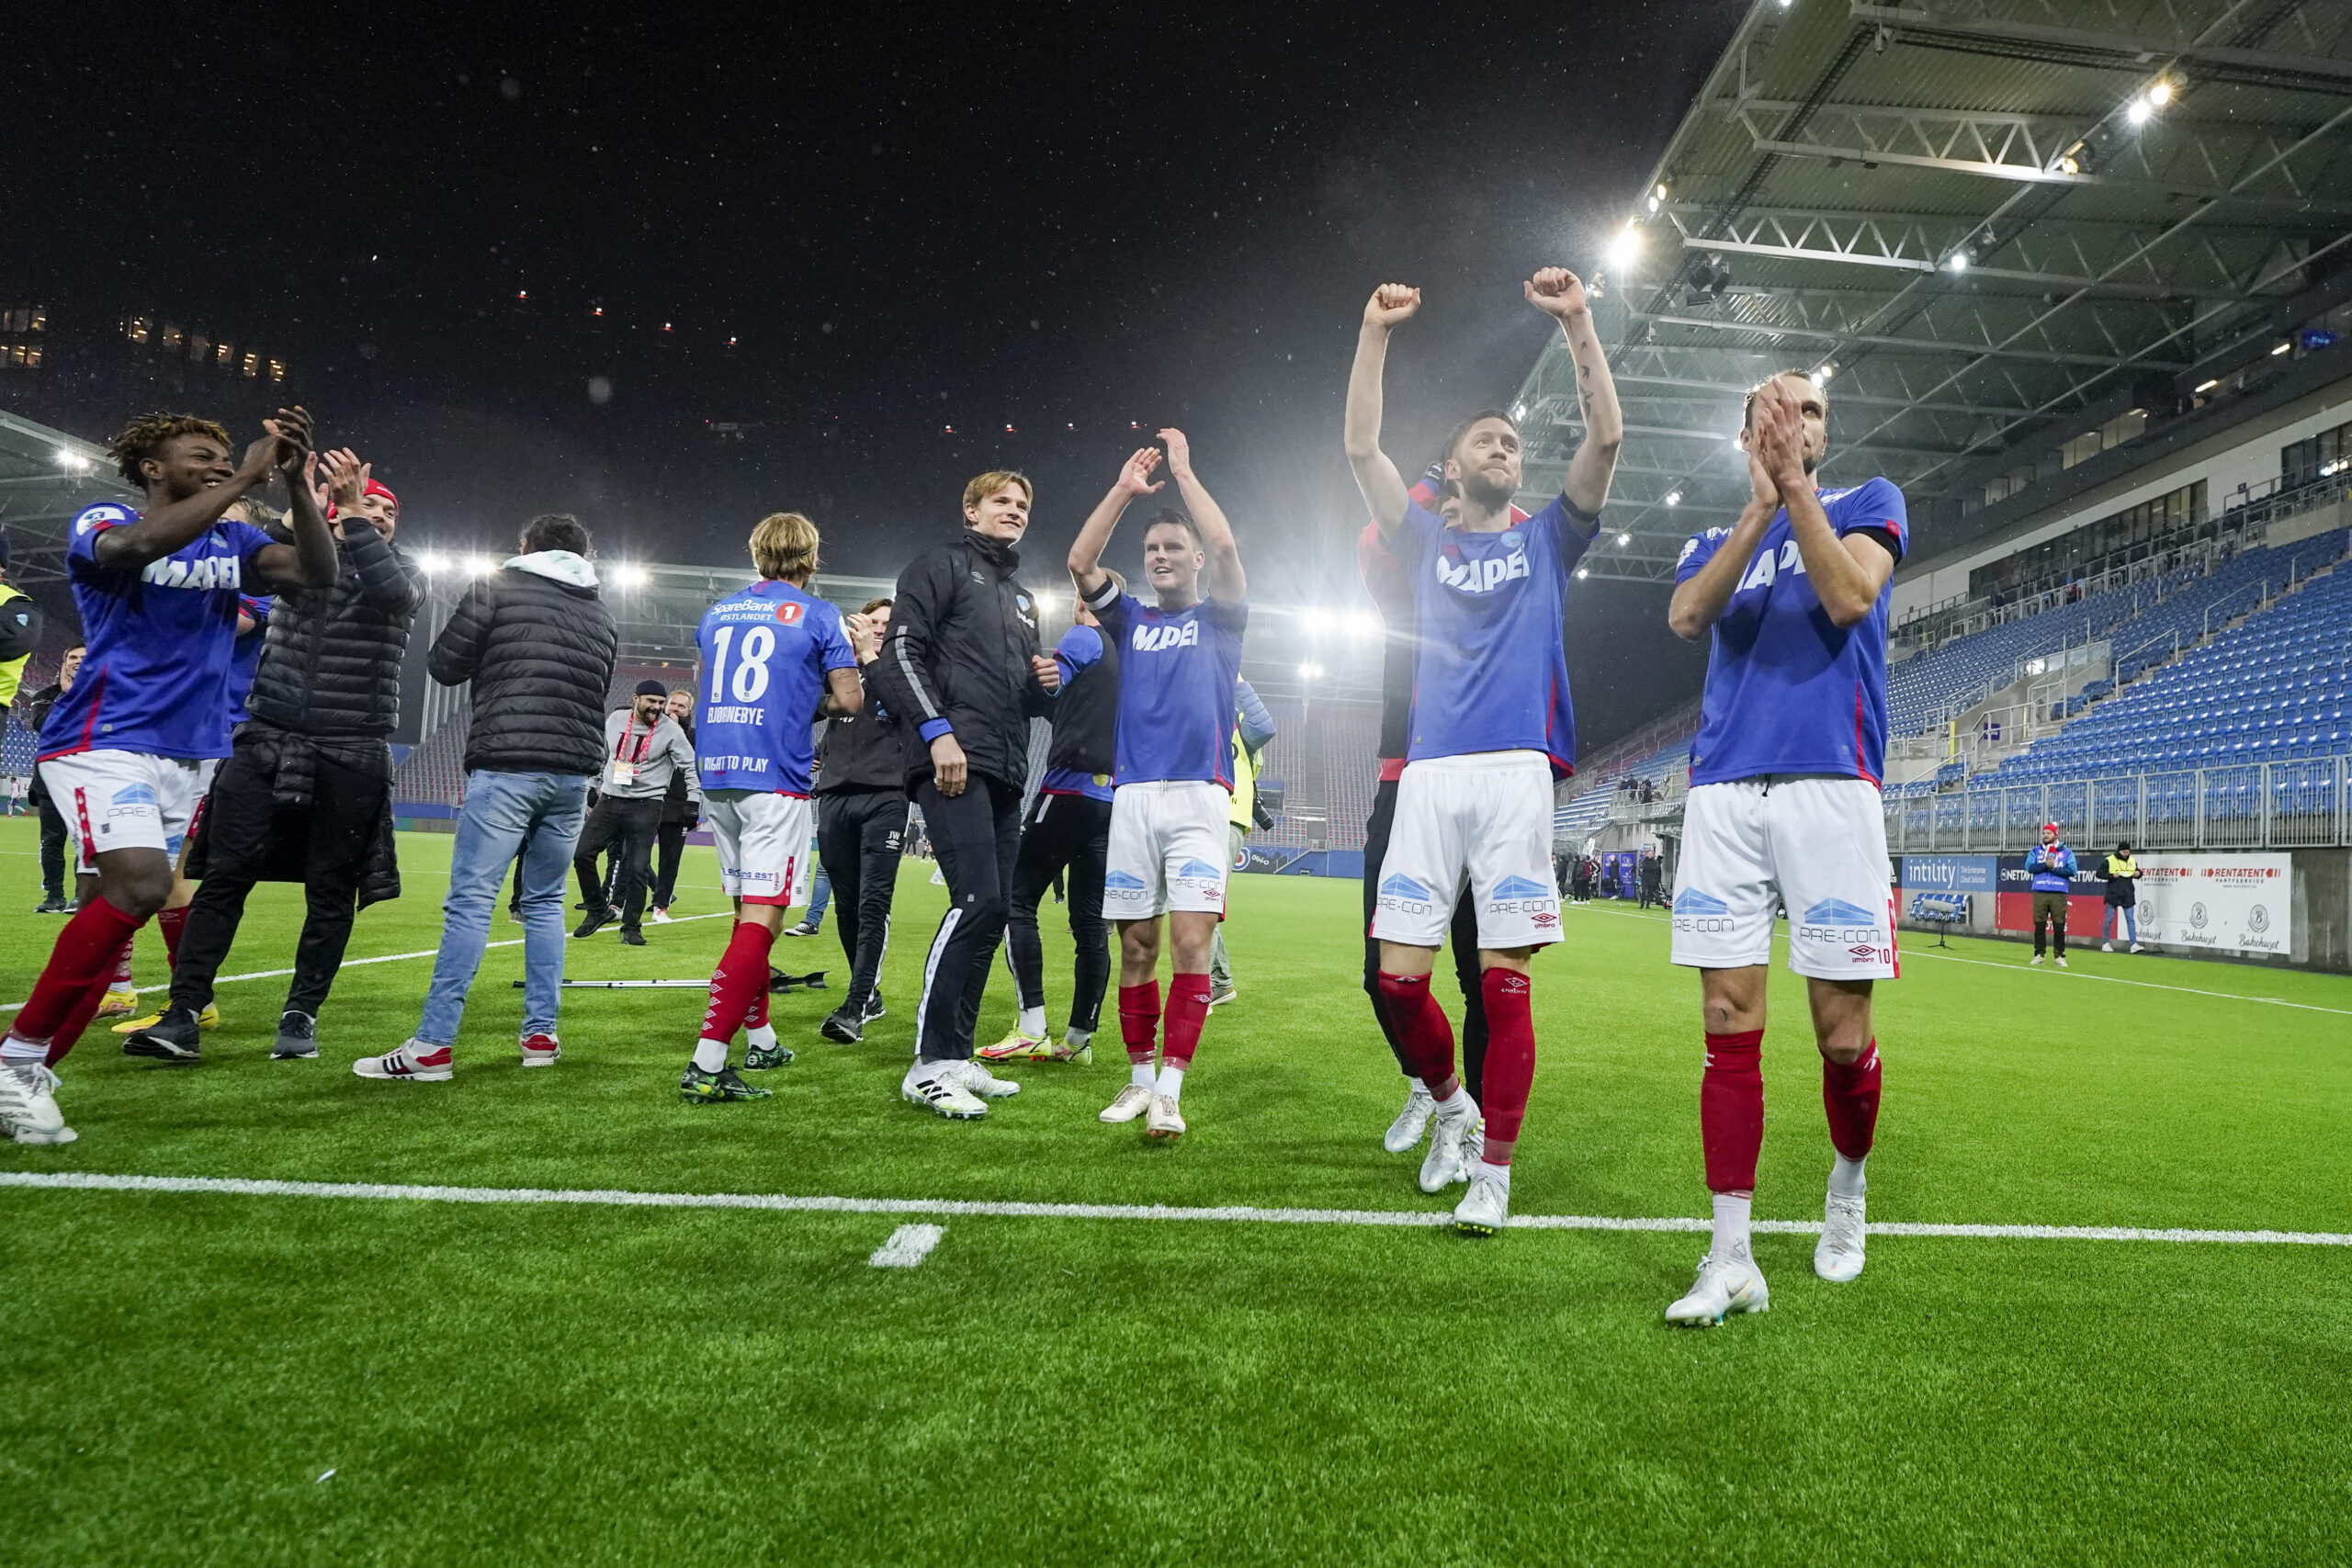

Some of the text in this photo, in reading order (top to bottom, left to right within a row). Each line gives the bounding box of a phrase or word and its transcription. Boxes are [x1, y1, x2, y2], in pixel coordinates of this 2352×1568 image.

[141, 555, 241, 591] MAPEI
[1436, 543, 1530, 593] MAPEI
[711, 599, 796, 620] SpareBank 1
[720, 613, 774, 622] ØSTLANDET
[710, 626, 775, 704] 18
[704, 755, 769, 773] RIGHT TO PLAY
[888, 830, 900, 840] JW
[1908, 859, 1955, 889] intility
[2215, 868, 2266, 877] RENTATENT
[1489, 899, 1555, 915] PRE-CON
[1800, 927, 1881, 943] PRE-CON
[1877, 949, 1891, 964] 10
